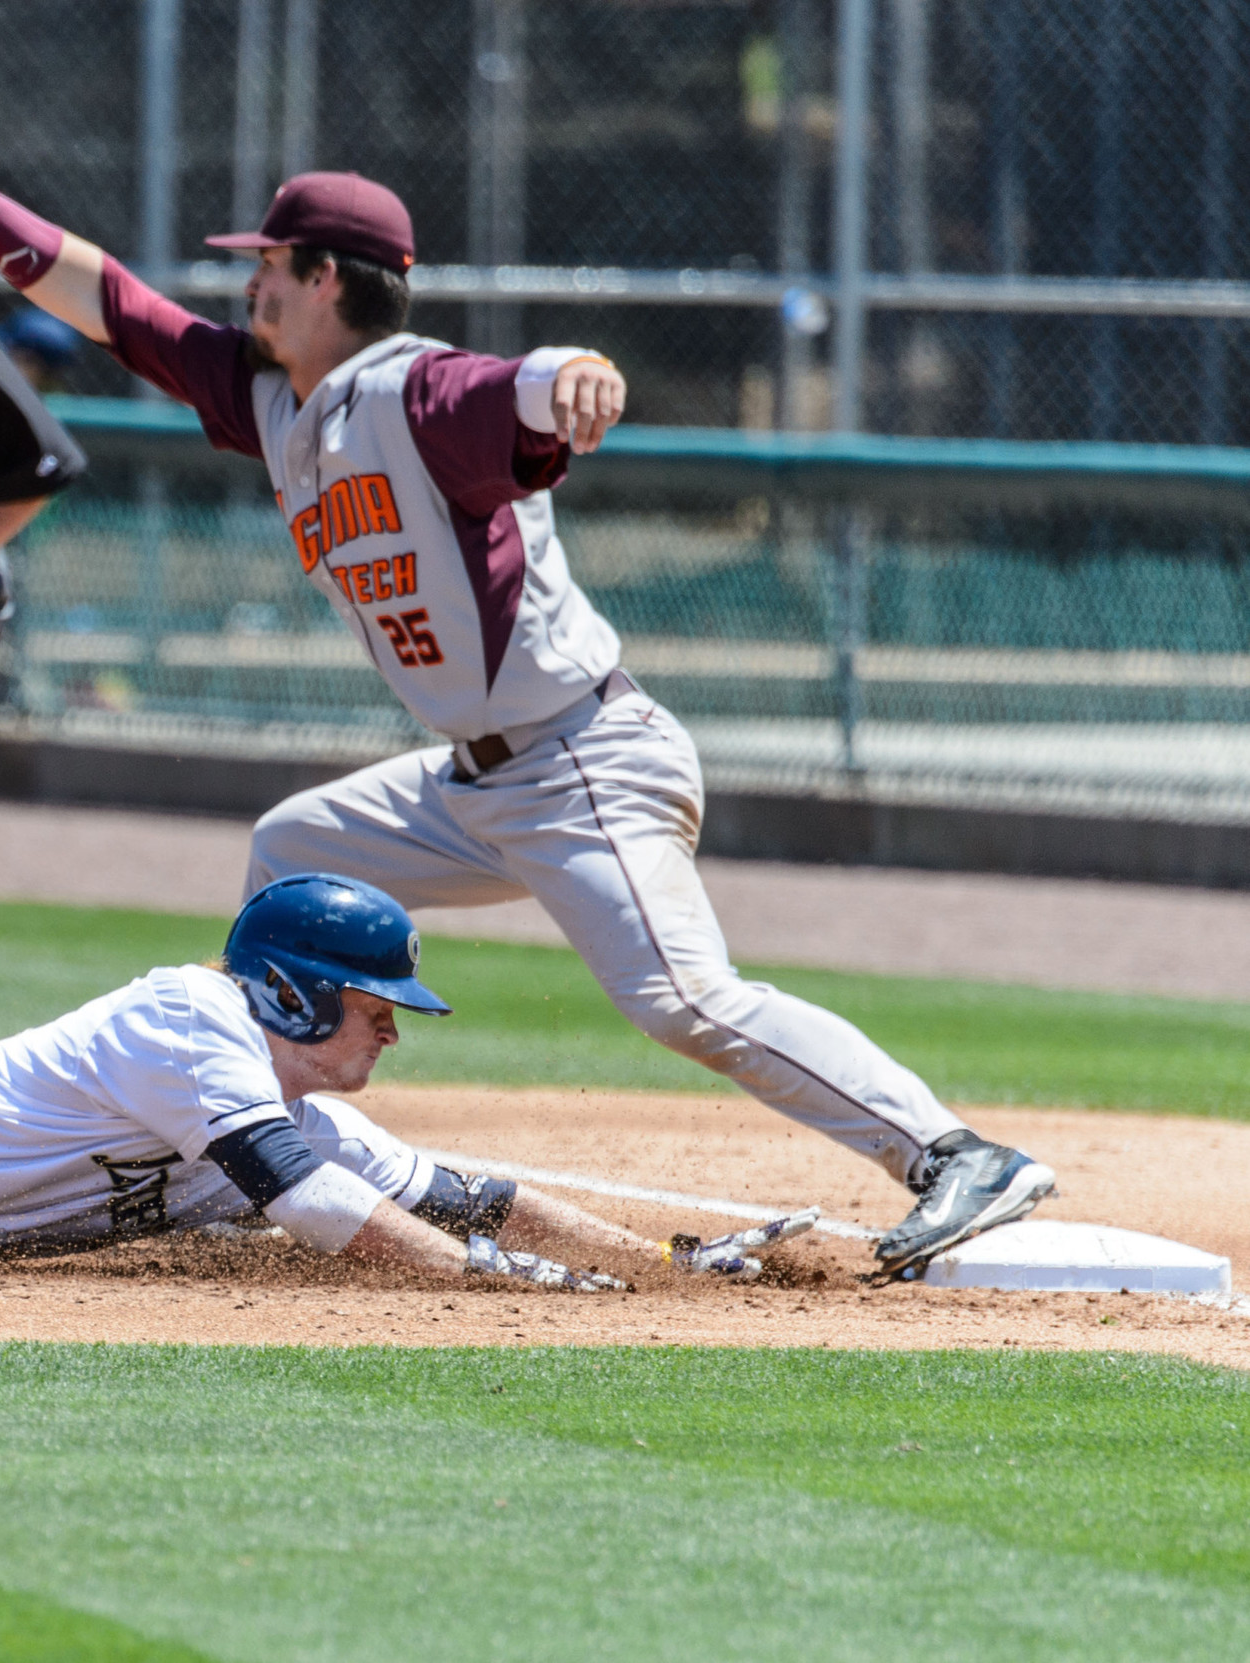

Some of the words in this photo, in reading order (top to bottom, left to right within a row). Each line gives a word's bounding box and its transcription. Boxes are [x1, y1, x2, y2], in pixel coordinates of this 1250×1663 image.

[276, 473, 403, 576] GINIA
[332, 552, 417, 604] TECH
[375, 607, 445, 669] 25
